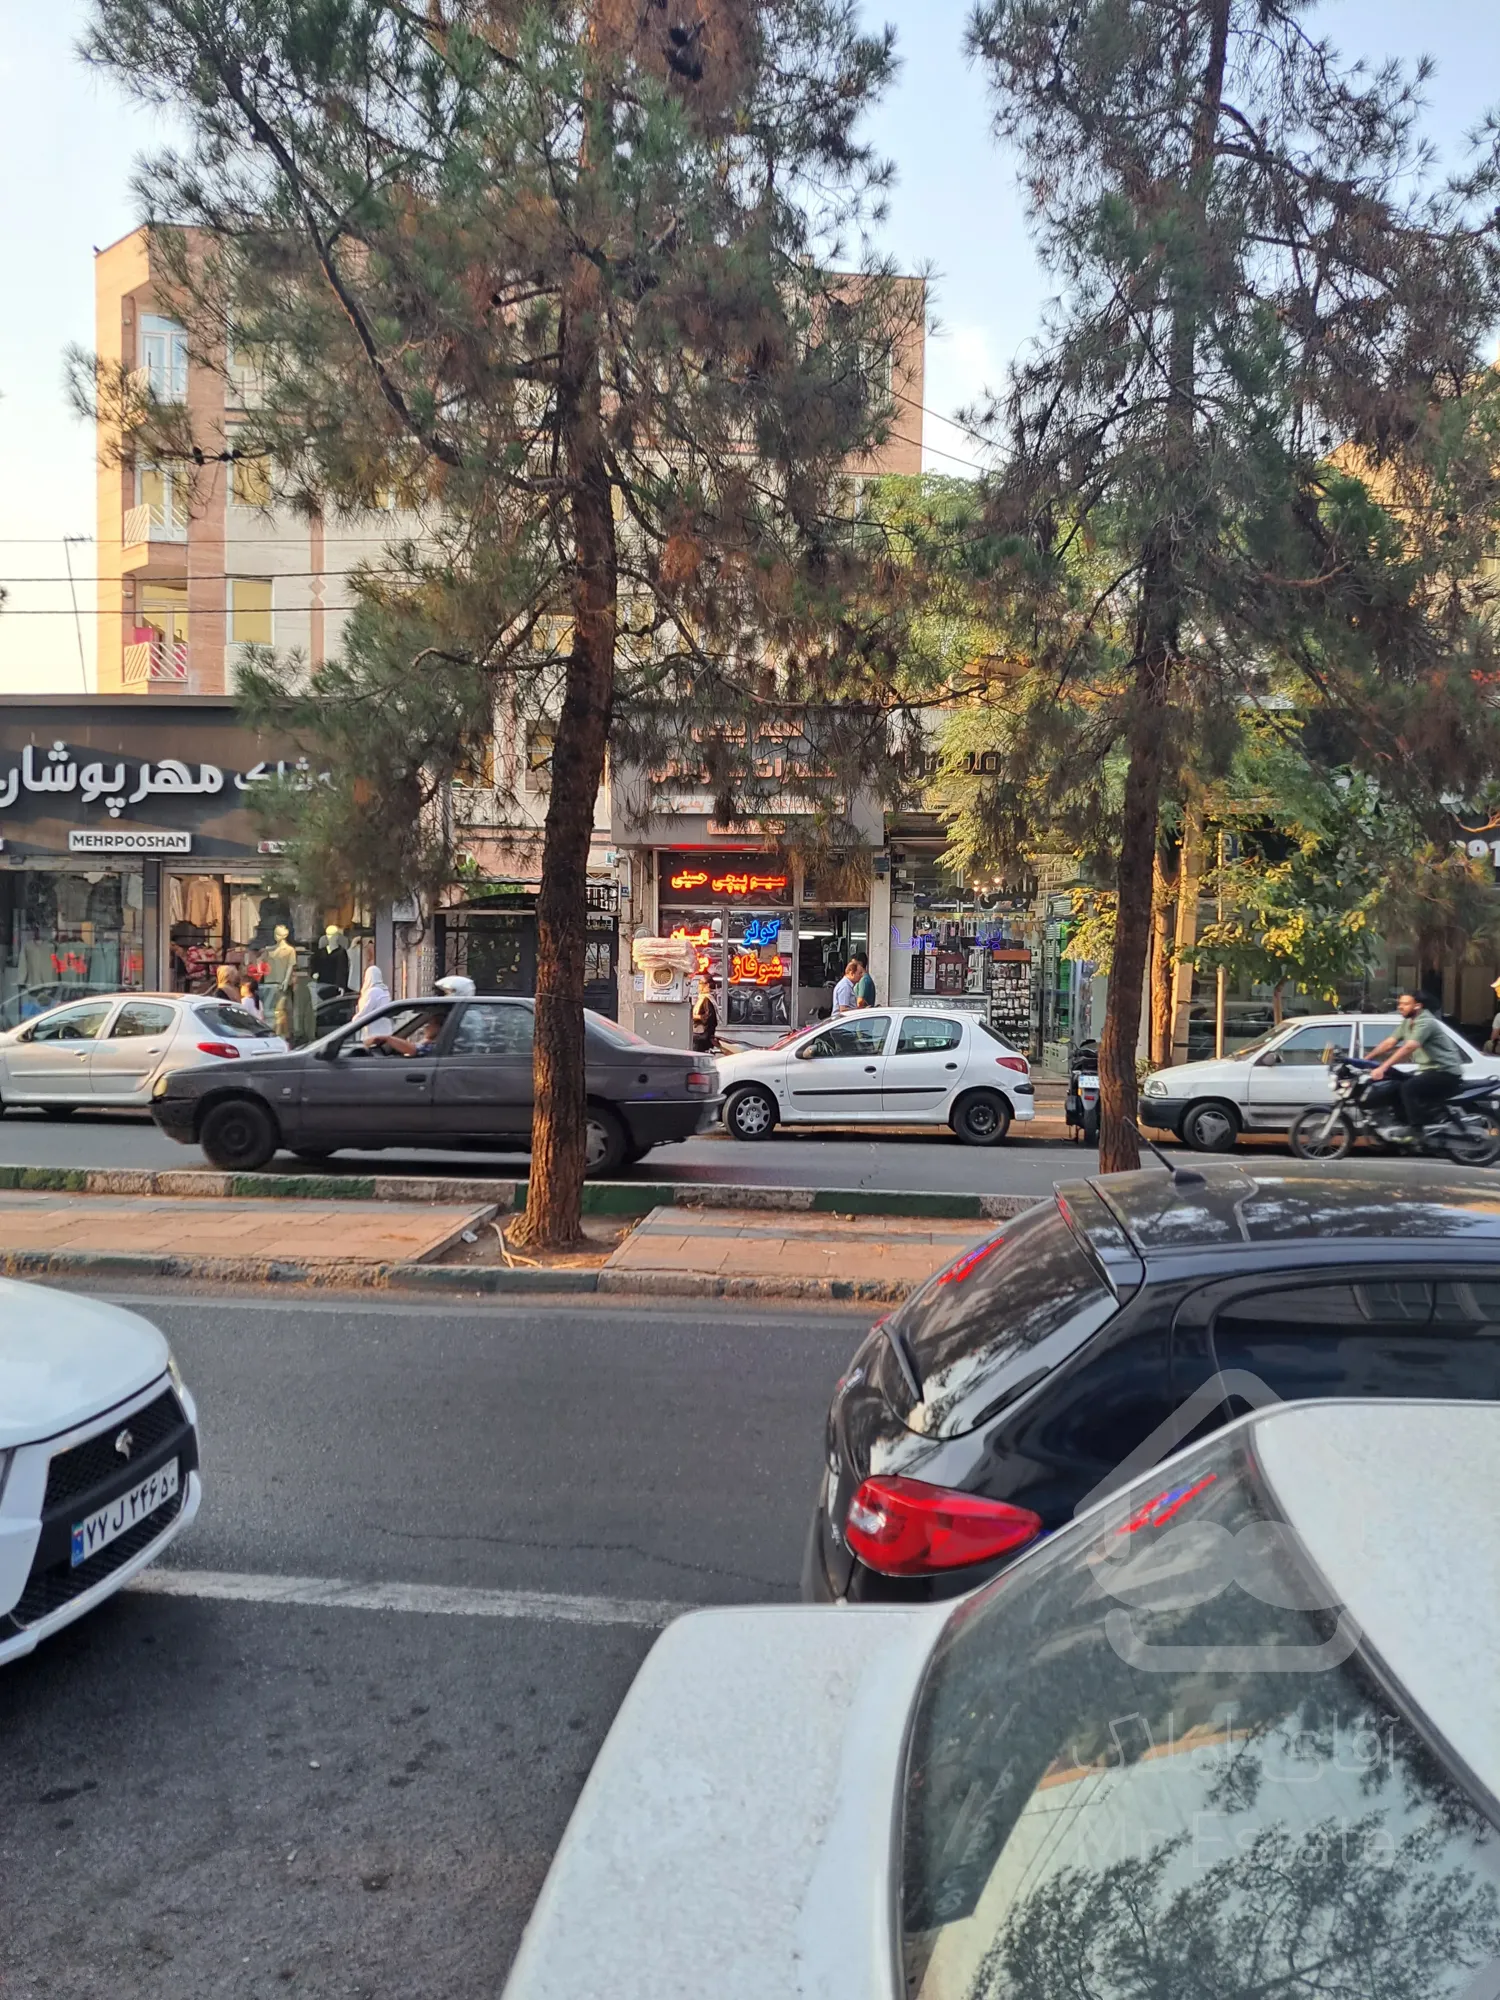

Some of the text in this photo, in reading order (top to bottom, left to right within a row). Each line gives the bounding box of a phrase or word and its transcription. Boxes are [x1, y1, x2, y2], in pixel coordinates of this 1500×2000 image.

[72, 835, 187, 847] MEHRPOOSHAN
[671, 870, 786, 894] سیم پیچی حسینی
[742, 919, 780, 946] کولر
[729, 949, 783, 984] شوفاژ
